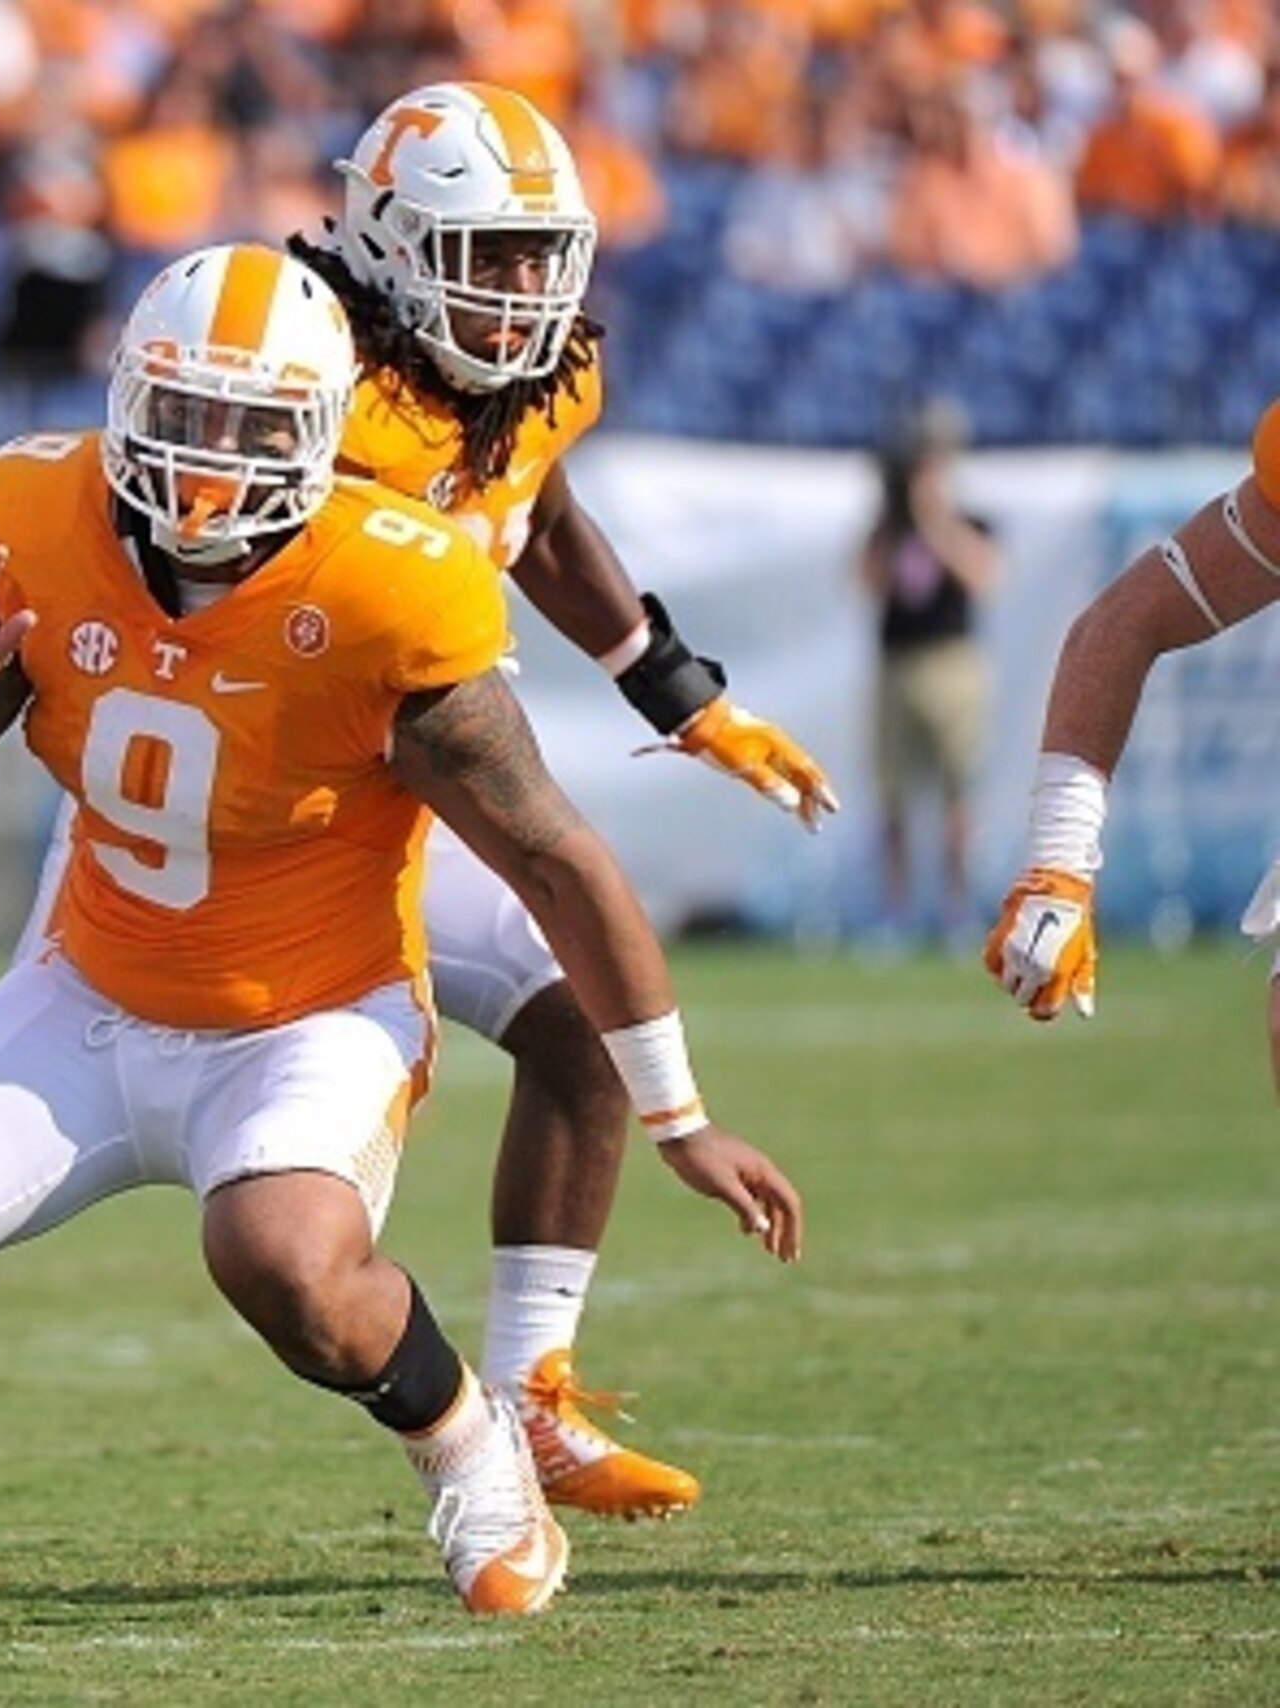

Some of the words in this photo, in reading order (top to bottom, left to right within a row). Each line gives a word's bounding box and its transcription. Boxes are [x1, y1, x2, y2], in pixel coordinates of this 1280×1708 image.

[362, 508, 451, 560] 9
[70, 621, 118, 674] SEC
[152, 638, 187, 681] T
[82, 687, 219, 909] 9
